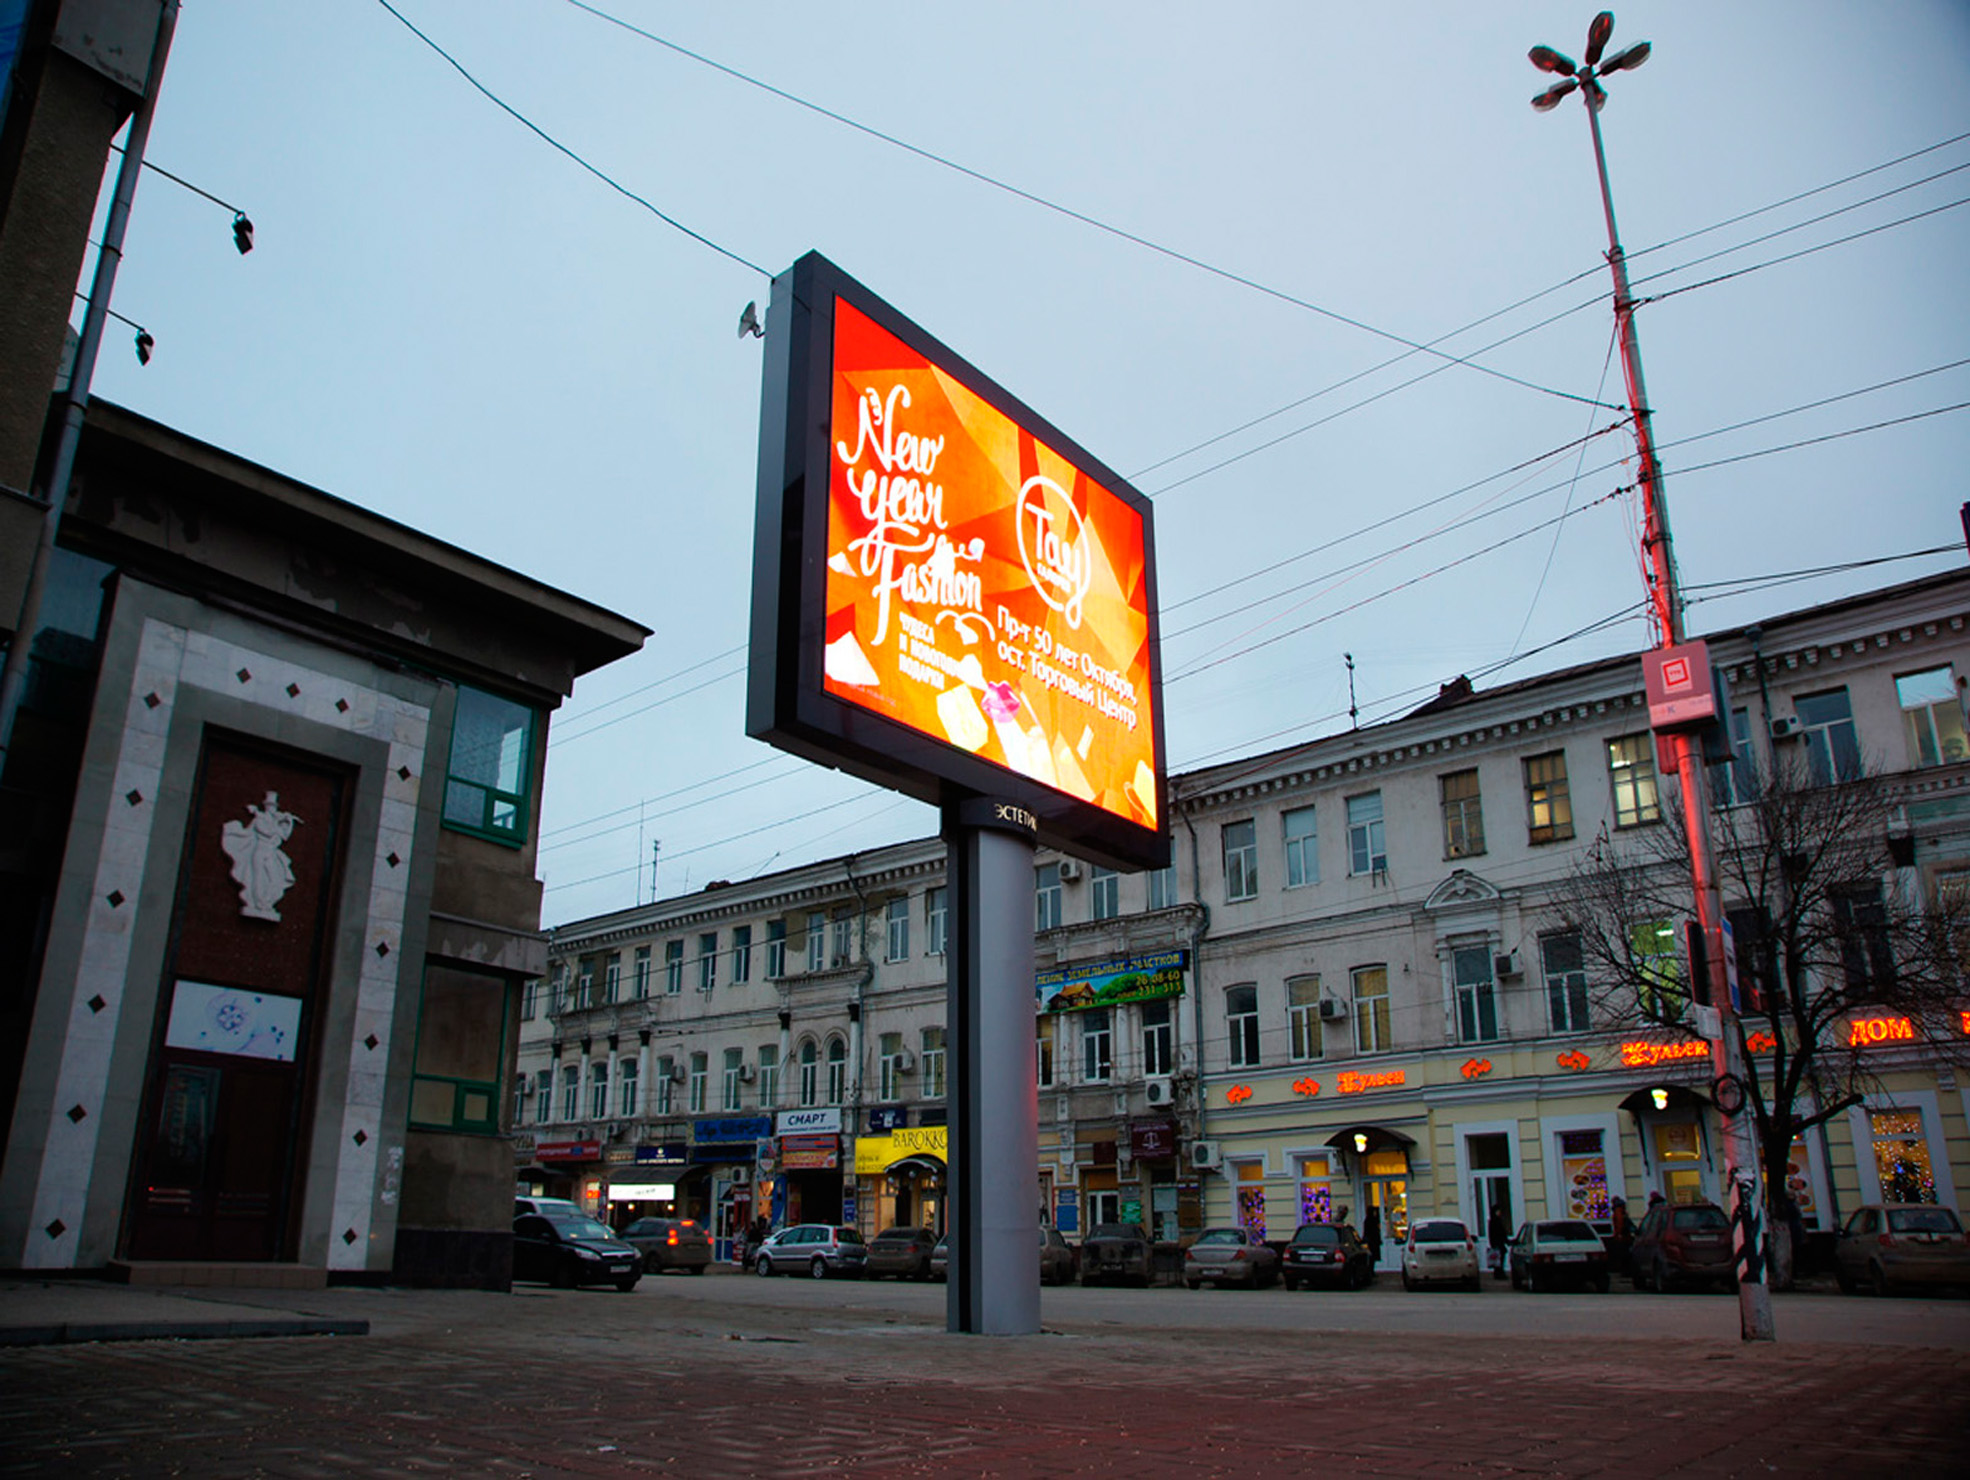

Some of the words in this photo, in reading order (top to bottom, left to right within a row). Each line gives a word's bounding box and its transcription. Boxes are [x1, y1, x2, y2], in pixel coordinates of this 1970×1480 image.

[837, 384, 945, 476] New
[998, 605, 1031, 643] Пр-т
[1034, 625, 1052, 655] 50
[1055, 643, 1079, 670] лет
[1081, 653, 1138, 707] Октября,
[998, 641, 1026, 671] ост.
[1028, 650, 1095, 708] Торговый
[1097, 687, 1137, 732] Центр
[1849, 1017, 1915, 1046] ДОМ
[1336, 1069, 1405, 1094] Жульен
[787, 1112, 828, 1127] СМАРТ
